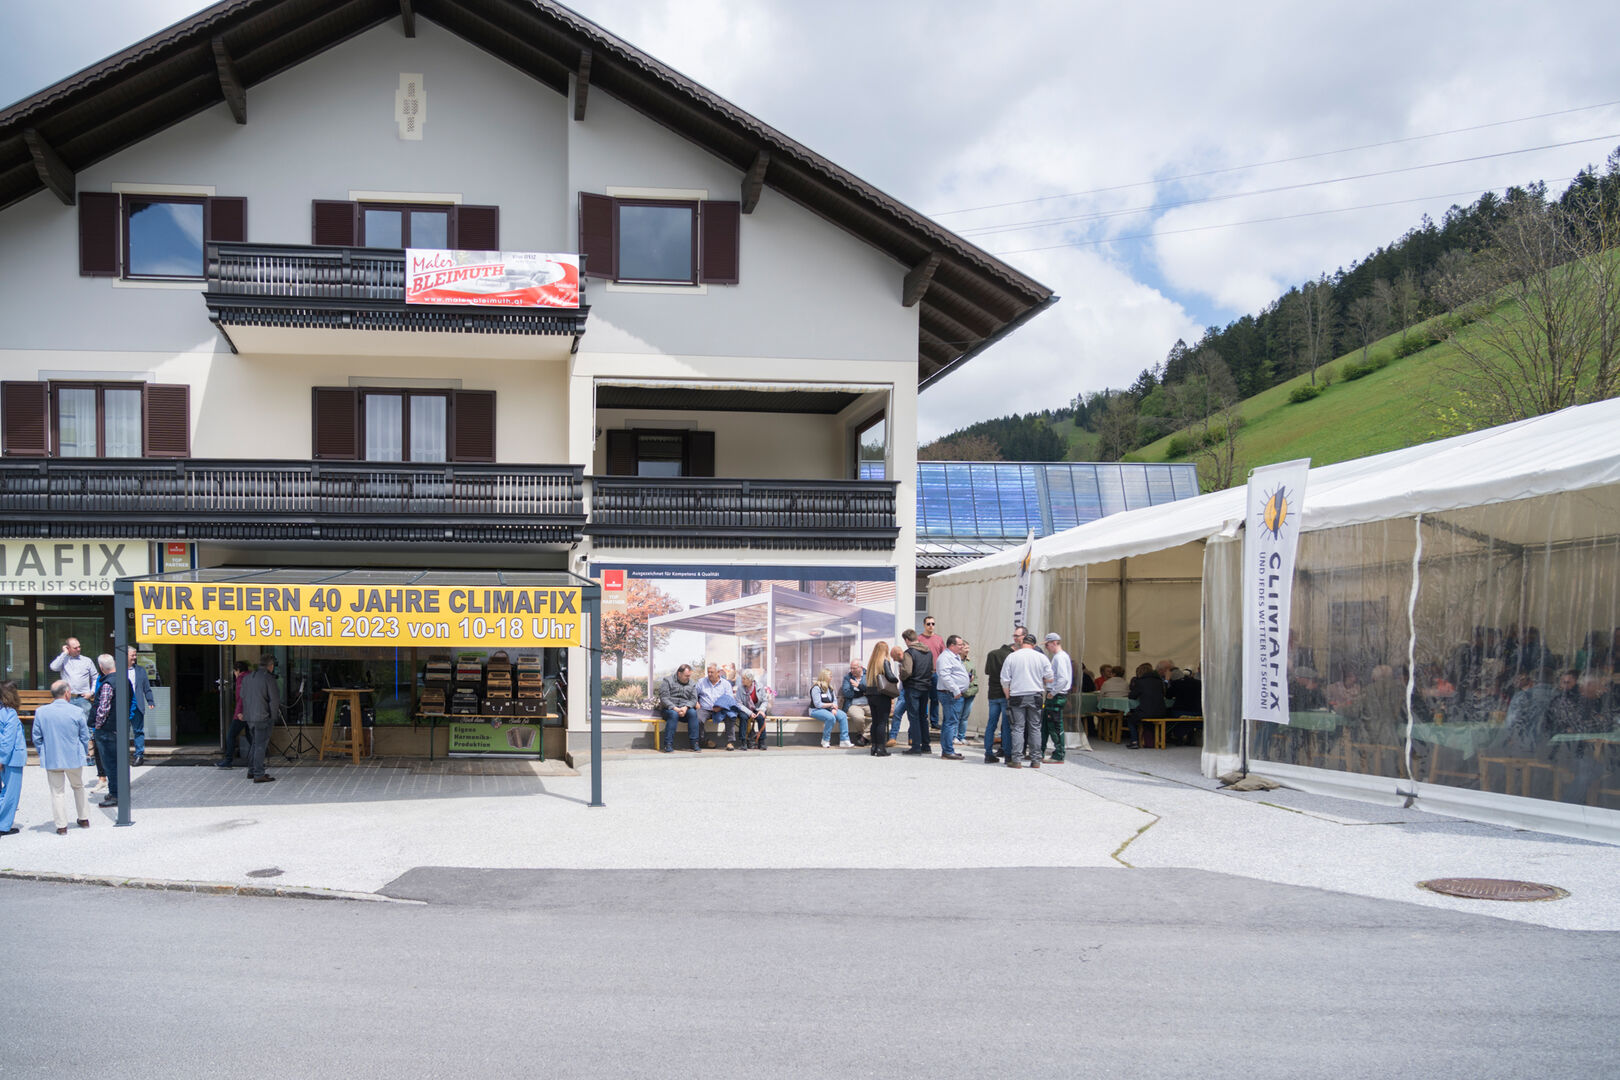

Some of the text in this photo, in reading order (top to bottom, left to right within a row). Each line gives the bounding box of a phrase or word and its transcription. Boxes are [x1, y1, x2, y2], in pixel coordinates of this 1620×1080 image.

[412, 252, 455, 273] Maler
[411, 266, 505, 294] BLEIMUTH
[0, 544, 127, 577] AFIX
[0, 578, 110, 591] TTER IST SCHÖ
[139, 586, 577, 614] WIR FEIERN 40 JAHRE CLIMAFIX
[141, 613, 575, 641] Freitag, 19. Mai 2023 von 10-18 Uhr
[1258, 610, 1267, 651] WETTER
[1268, 552, 1281, 711] CLIMAFIX
[1260, 653, 1268, 668] IST
